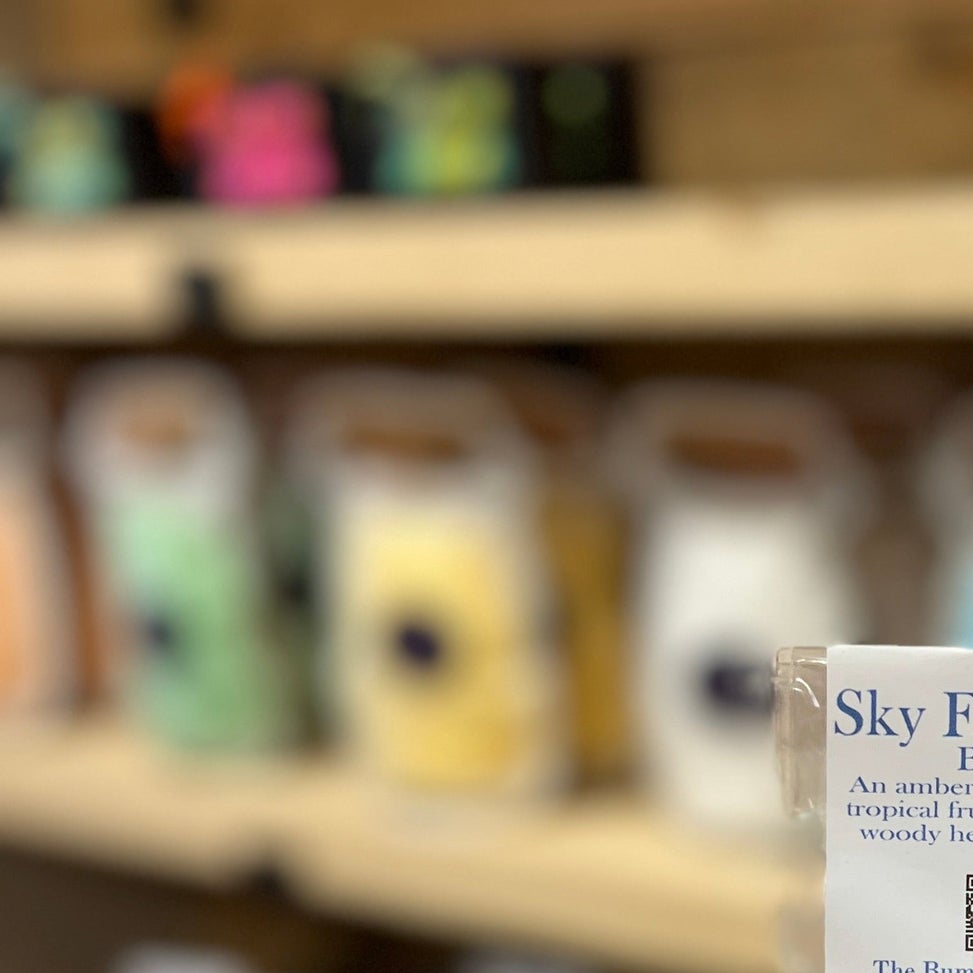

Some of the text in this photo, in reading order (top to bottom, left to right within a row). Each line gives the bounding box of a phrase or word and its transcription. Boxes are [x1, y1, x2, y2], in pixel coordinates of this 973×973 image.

[834, 688, 926, 747] Sky
[849, 776, 886, 793] An
[847, 800, 939, 821] tropical
[860, 824, 941, 845] woody
